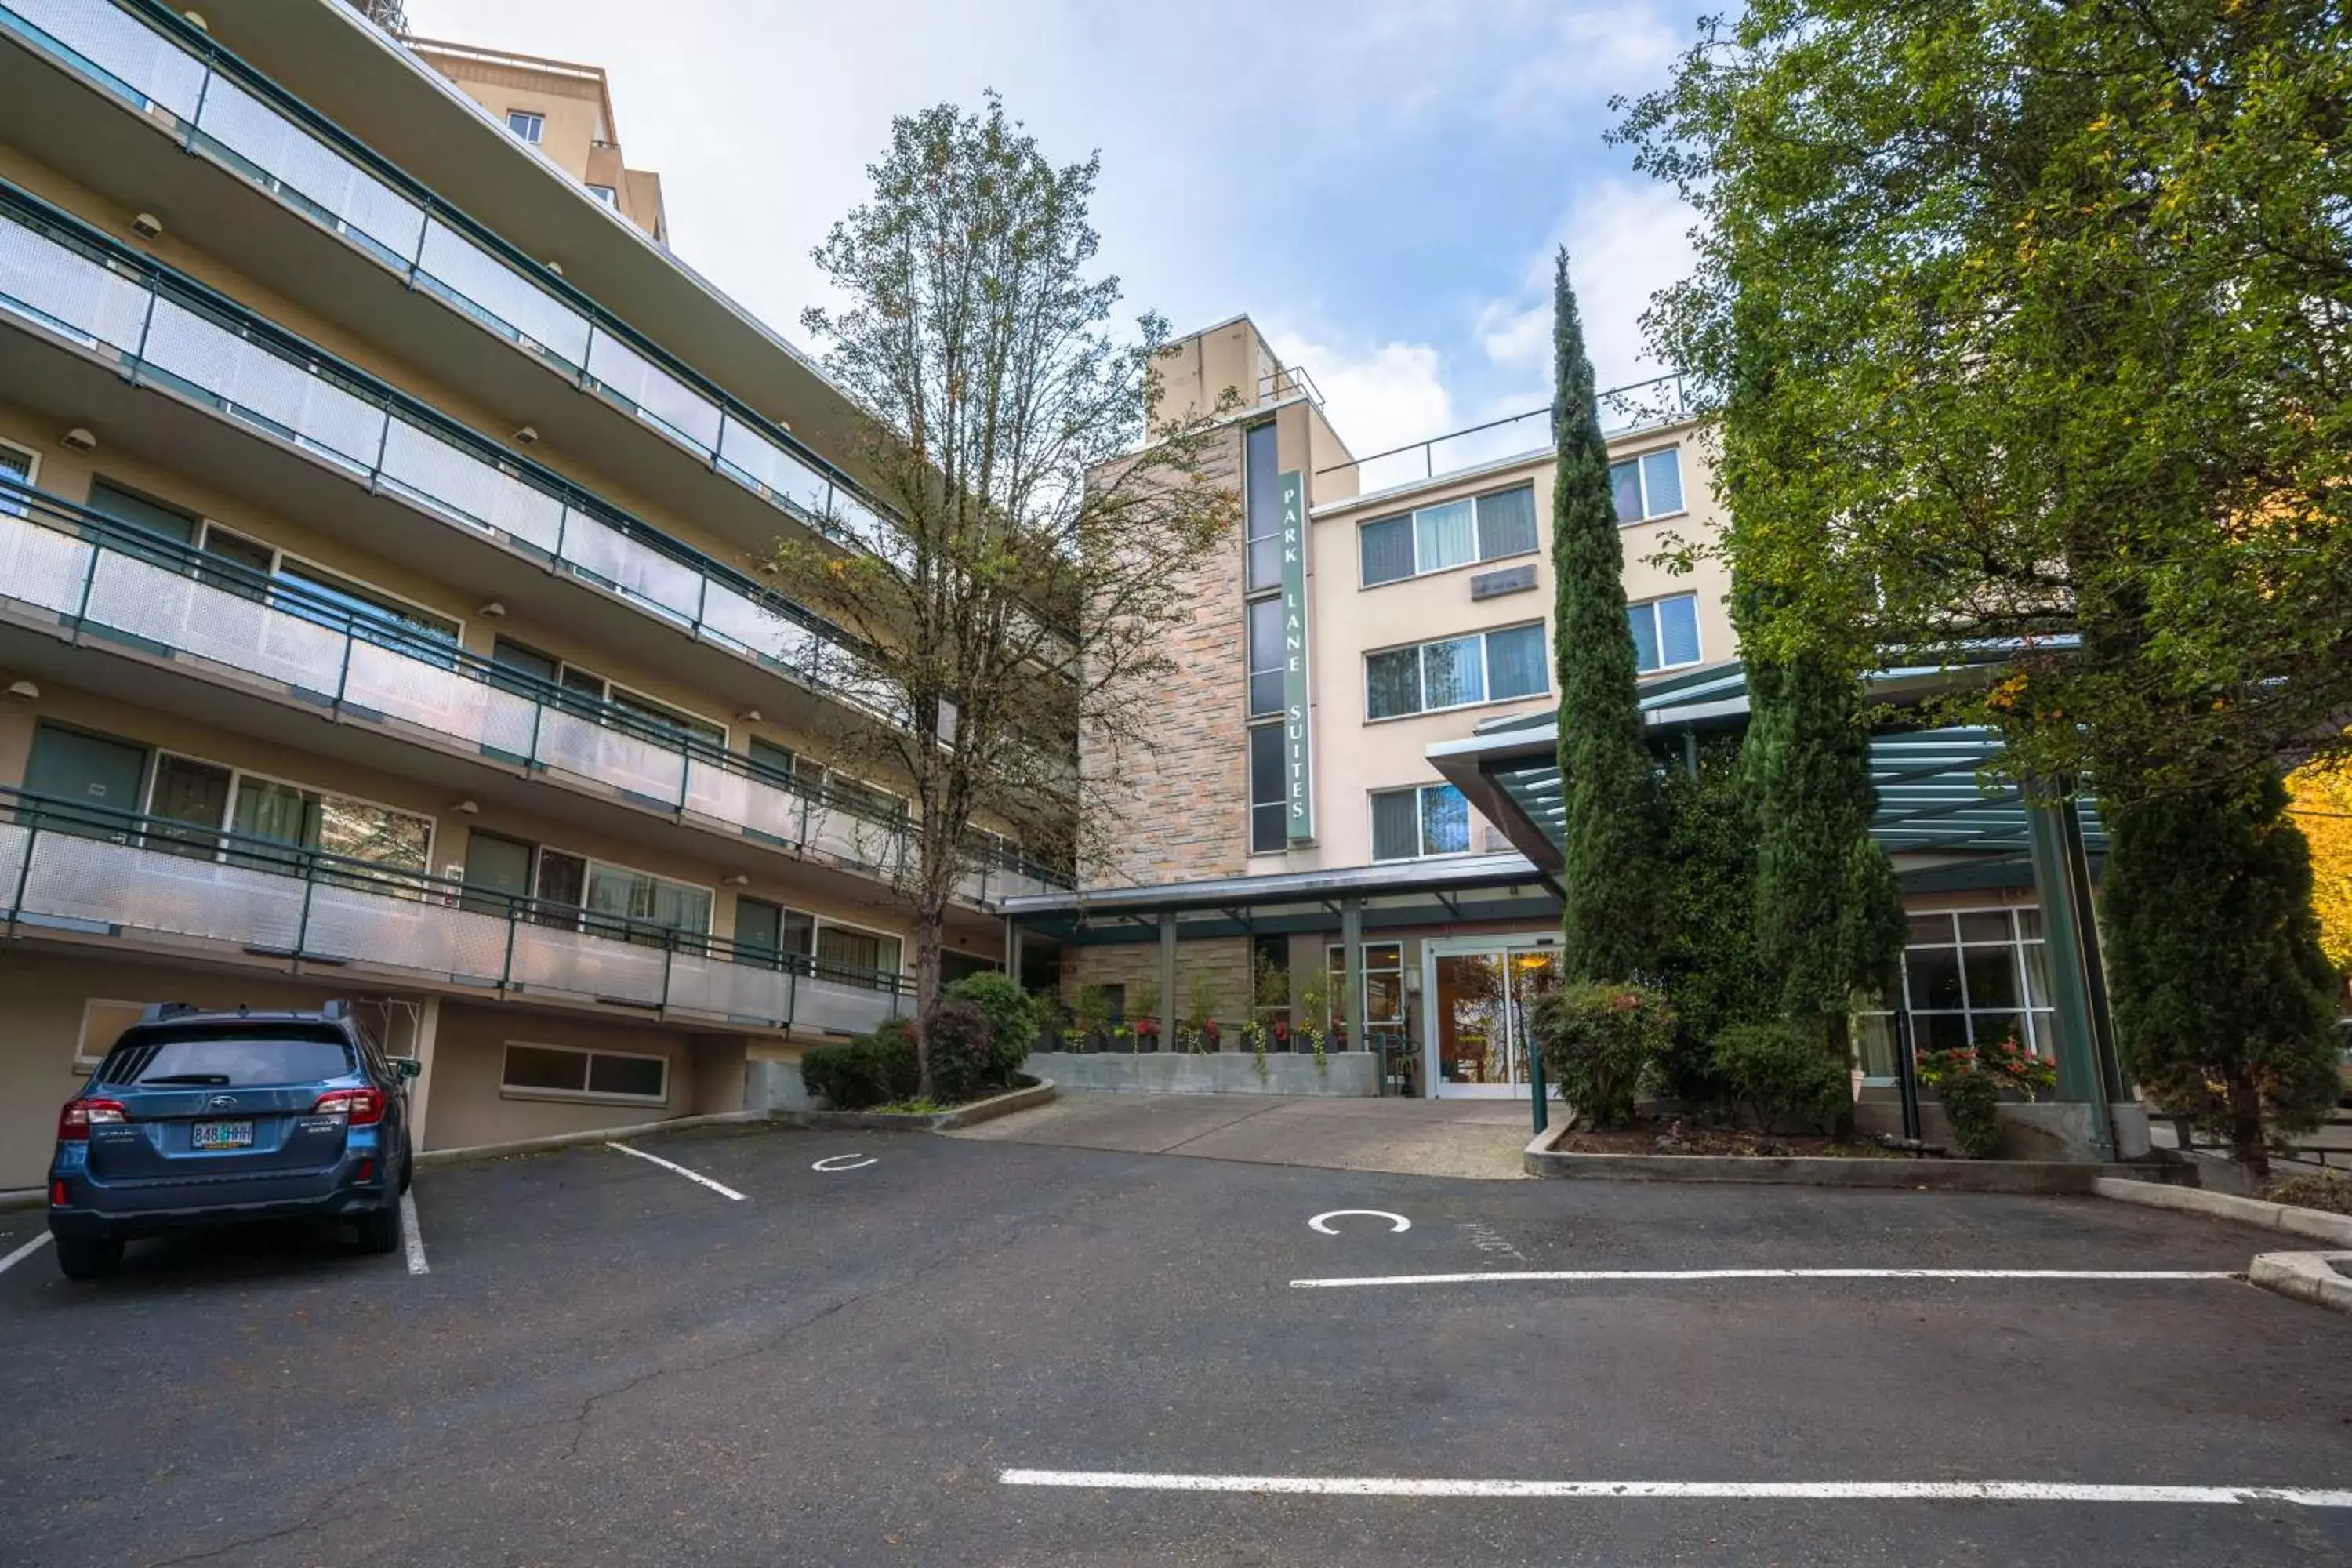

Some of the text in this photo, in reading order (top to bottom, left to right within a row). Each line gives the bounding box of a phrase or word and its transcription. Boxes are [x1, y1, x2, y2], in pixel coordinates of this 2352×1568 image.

[1283, 488, 1304, 817] PARK LANE SUITES
